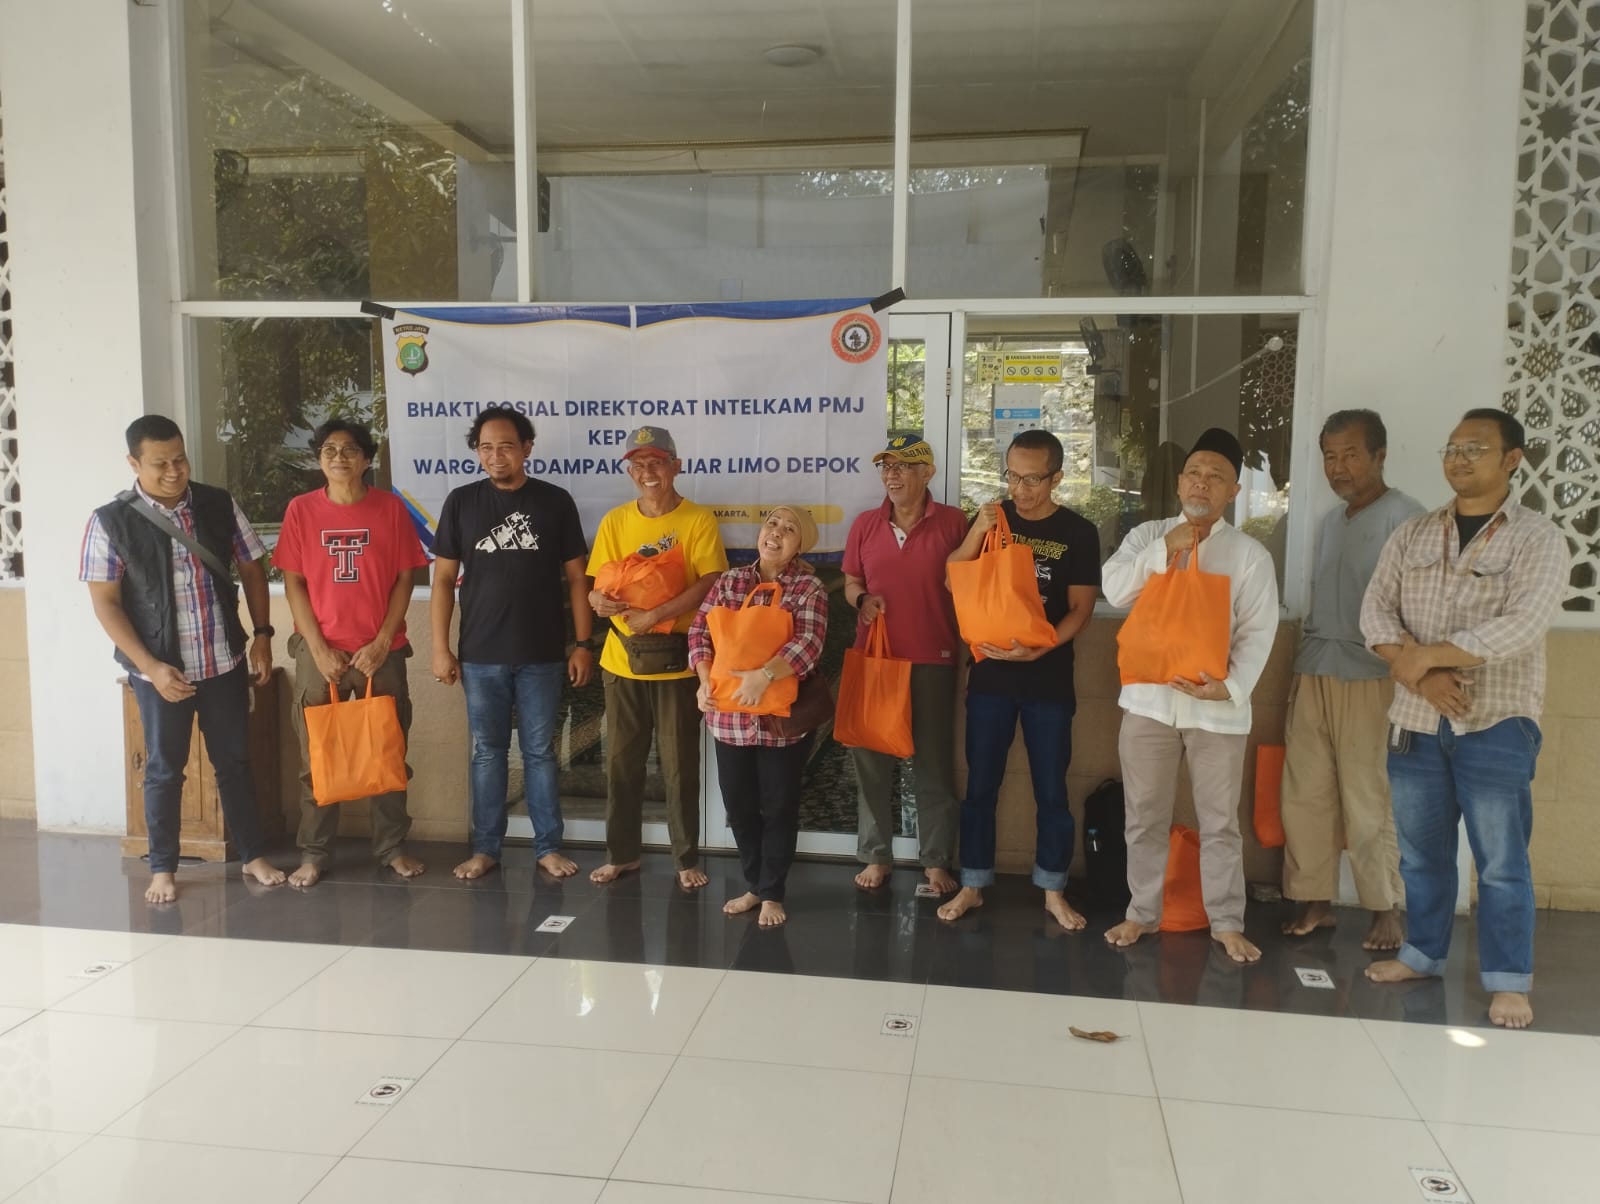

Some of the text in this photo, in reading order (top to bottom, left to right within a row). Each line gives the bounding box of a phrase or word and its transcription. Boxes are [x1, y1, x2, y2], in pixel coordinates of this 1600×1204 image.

[407, 401, 481, 417] BHAKTI
[565, 400, 698, 416] DIREKTORAT
[704, 397, 812, 415] INTELKAM
[819, 397, 864, 413] PMJ
[588, 429, 626, 445] KEP
[522, 458, 624, 474] RDAMPAK
[727, 457, 780, 473] LIMO
[786, 457, 861, 473] DEPOK
